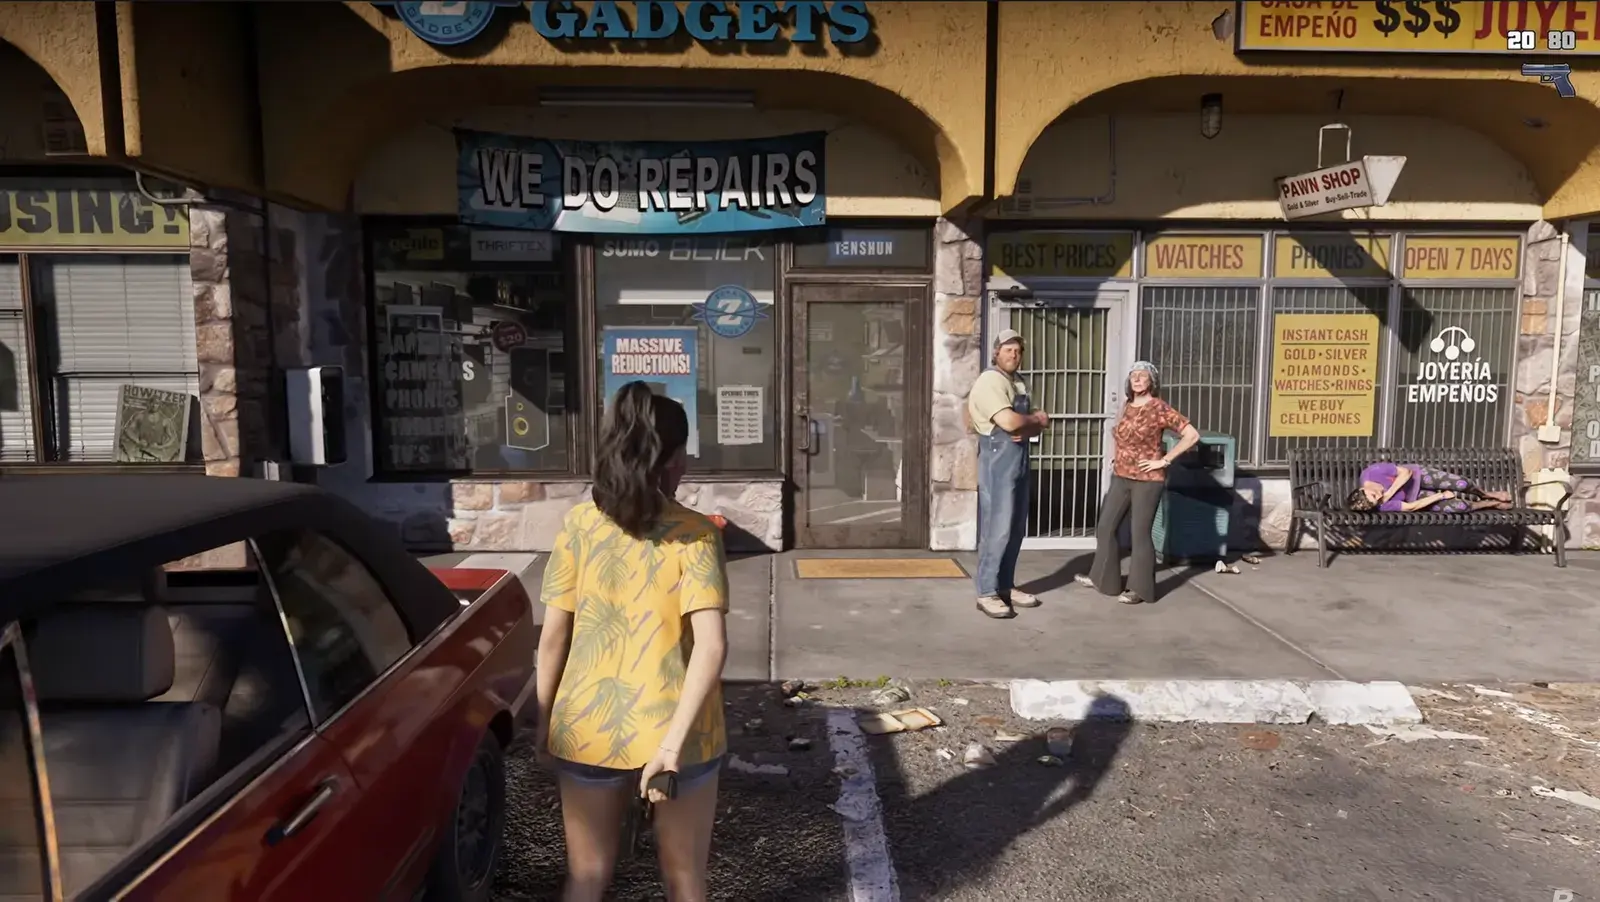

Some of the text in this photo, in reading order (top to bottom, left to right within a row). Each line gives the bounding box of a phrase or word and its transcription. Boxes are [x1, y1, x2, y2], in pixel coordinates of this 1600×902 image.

[406, 7, 482, 35] GADGETS
[530, 1, 870, 42] GADGETS
[1373, 1, 1461, 39] $$$
[1475, 1, 1600, 40] JOYE
[478, 150, 817, 211] WE DO REPAIRS
[1281, 168, 1360, 198] PAWN SHOP
[1304, 200, 1319, 208] Silver
[477, 240, 547, 251] THRIFTEX
[602, 239, 660, 257] SUMO
[669, 238, 765, 260] BLICK
[834, 241, 893, 255] TENSHUN
[1001, 242, 1117, 268] BEST PRICES
[1155, 244, 1244, 269] WATCHES
[1291, 245, 1365, 269] PHONES
[1405, 247, 1513, 270] OPEN 7 DAYS
[616, 338, 683, 354] MASSIVE
[1282, 329, 1368, 341] INSTANT CASH
[611, 354, 690, 375] REDUCTIONS!
[1284, 349, 1367, 360] GOLD SILVER
[1287, 365, 1359, 376] DIAMONDS
[1416, 357, 1491, 380] JOYERÍA
[123, 385, 187, 404] HOWITZER
[1408, 380, 1498, 403] EMPEÑOS
[1298, 399, 1344, 411] WE BUY
[1280, 413, 1361, 424] CELL PHONES
